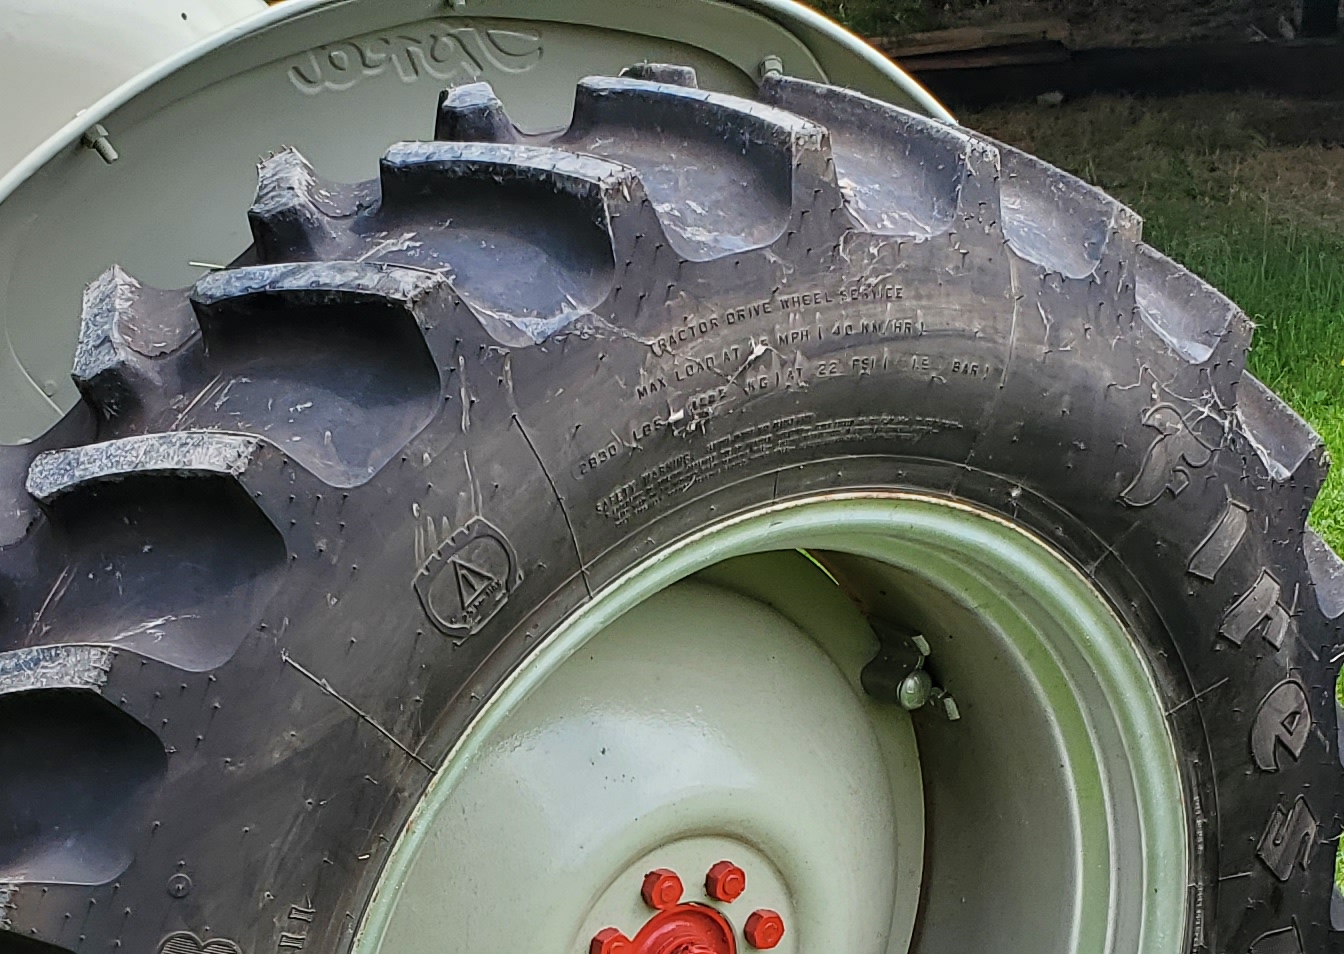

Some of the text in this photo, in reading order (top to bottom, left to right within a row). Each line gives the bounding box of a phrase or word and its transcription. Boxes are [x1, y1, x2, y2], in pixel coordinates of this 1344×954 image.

[726, 301, 773, 326] DRIVE
[779, 291, 833, 310] WHEEL
[636, 376, 667, 401] MAX
[674, 355, 716, 382] LOAD
[722, 346, 741, 363] AT
[777, 328, 810, 347] MPH
